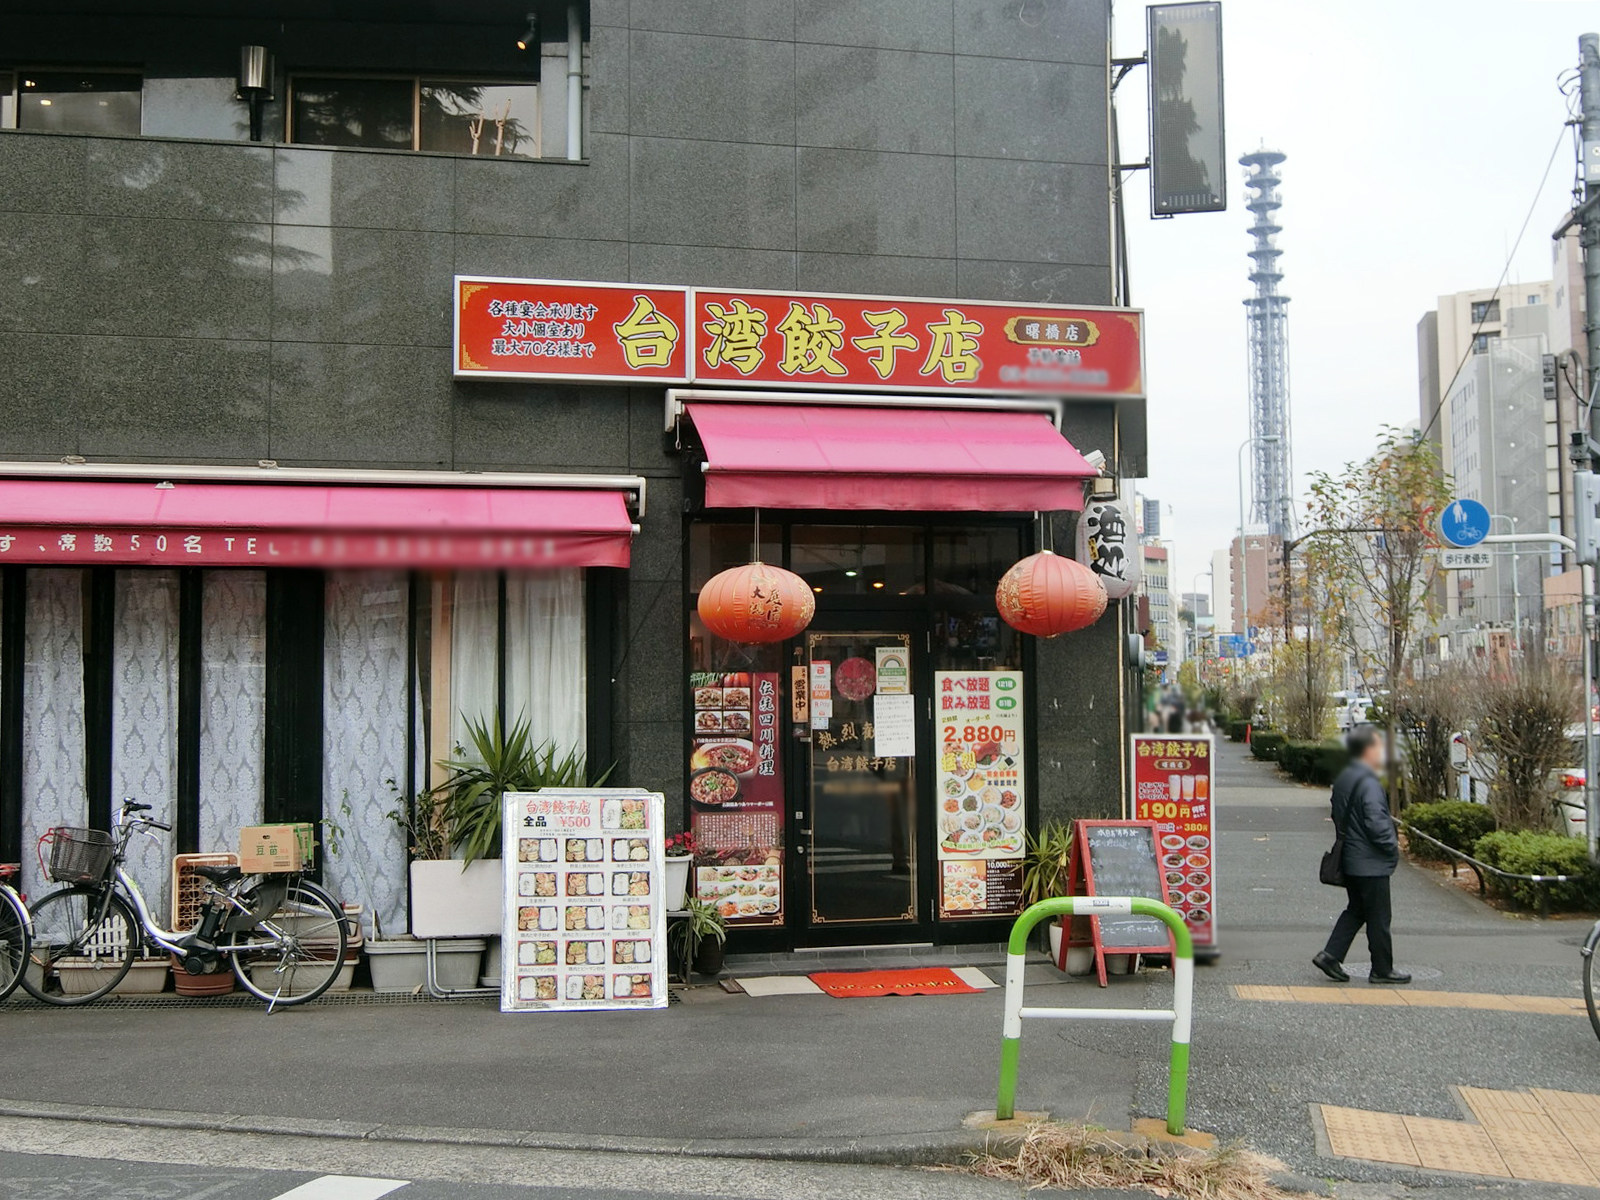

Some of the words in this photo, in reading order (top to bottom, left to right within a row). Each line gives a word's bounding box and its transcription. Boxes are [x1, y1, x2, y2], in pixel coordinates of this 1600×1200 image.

[488, 300, 598, 320] 各種宴会承ります
[502, 321, 586, 338] 大小個室あり
[1024, 321, 1080, 341] 曙橋店
[612, 294, 985, 384] 台湾餃子店
[491, 339, 597, 359] 最大70名様まで
[1446, 553, 1490, 565] 歩行者優先
[942, 677, 989, 691] 食べ放題
[794, 679, 806, 711] 営業中
[942, 696, 990, 710] 飲み放題
[759, 680, 775, 776] 伝統四川料理
[943, 725, 1016, 744] 2,880円
[1138, 742, 1208, 757] 台湾餃子店
[826, 756, 897, 772] 台湾餃子店
[525, 800, 592, 815] 台湾餃子店
[523, 815, 547, 828] 全品
[560, 816, 591, 828] ¥500
[1184, 823, 1208, 832] 380円
[256, 845, 278, 855] 豆苗
